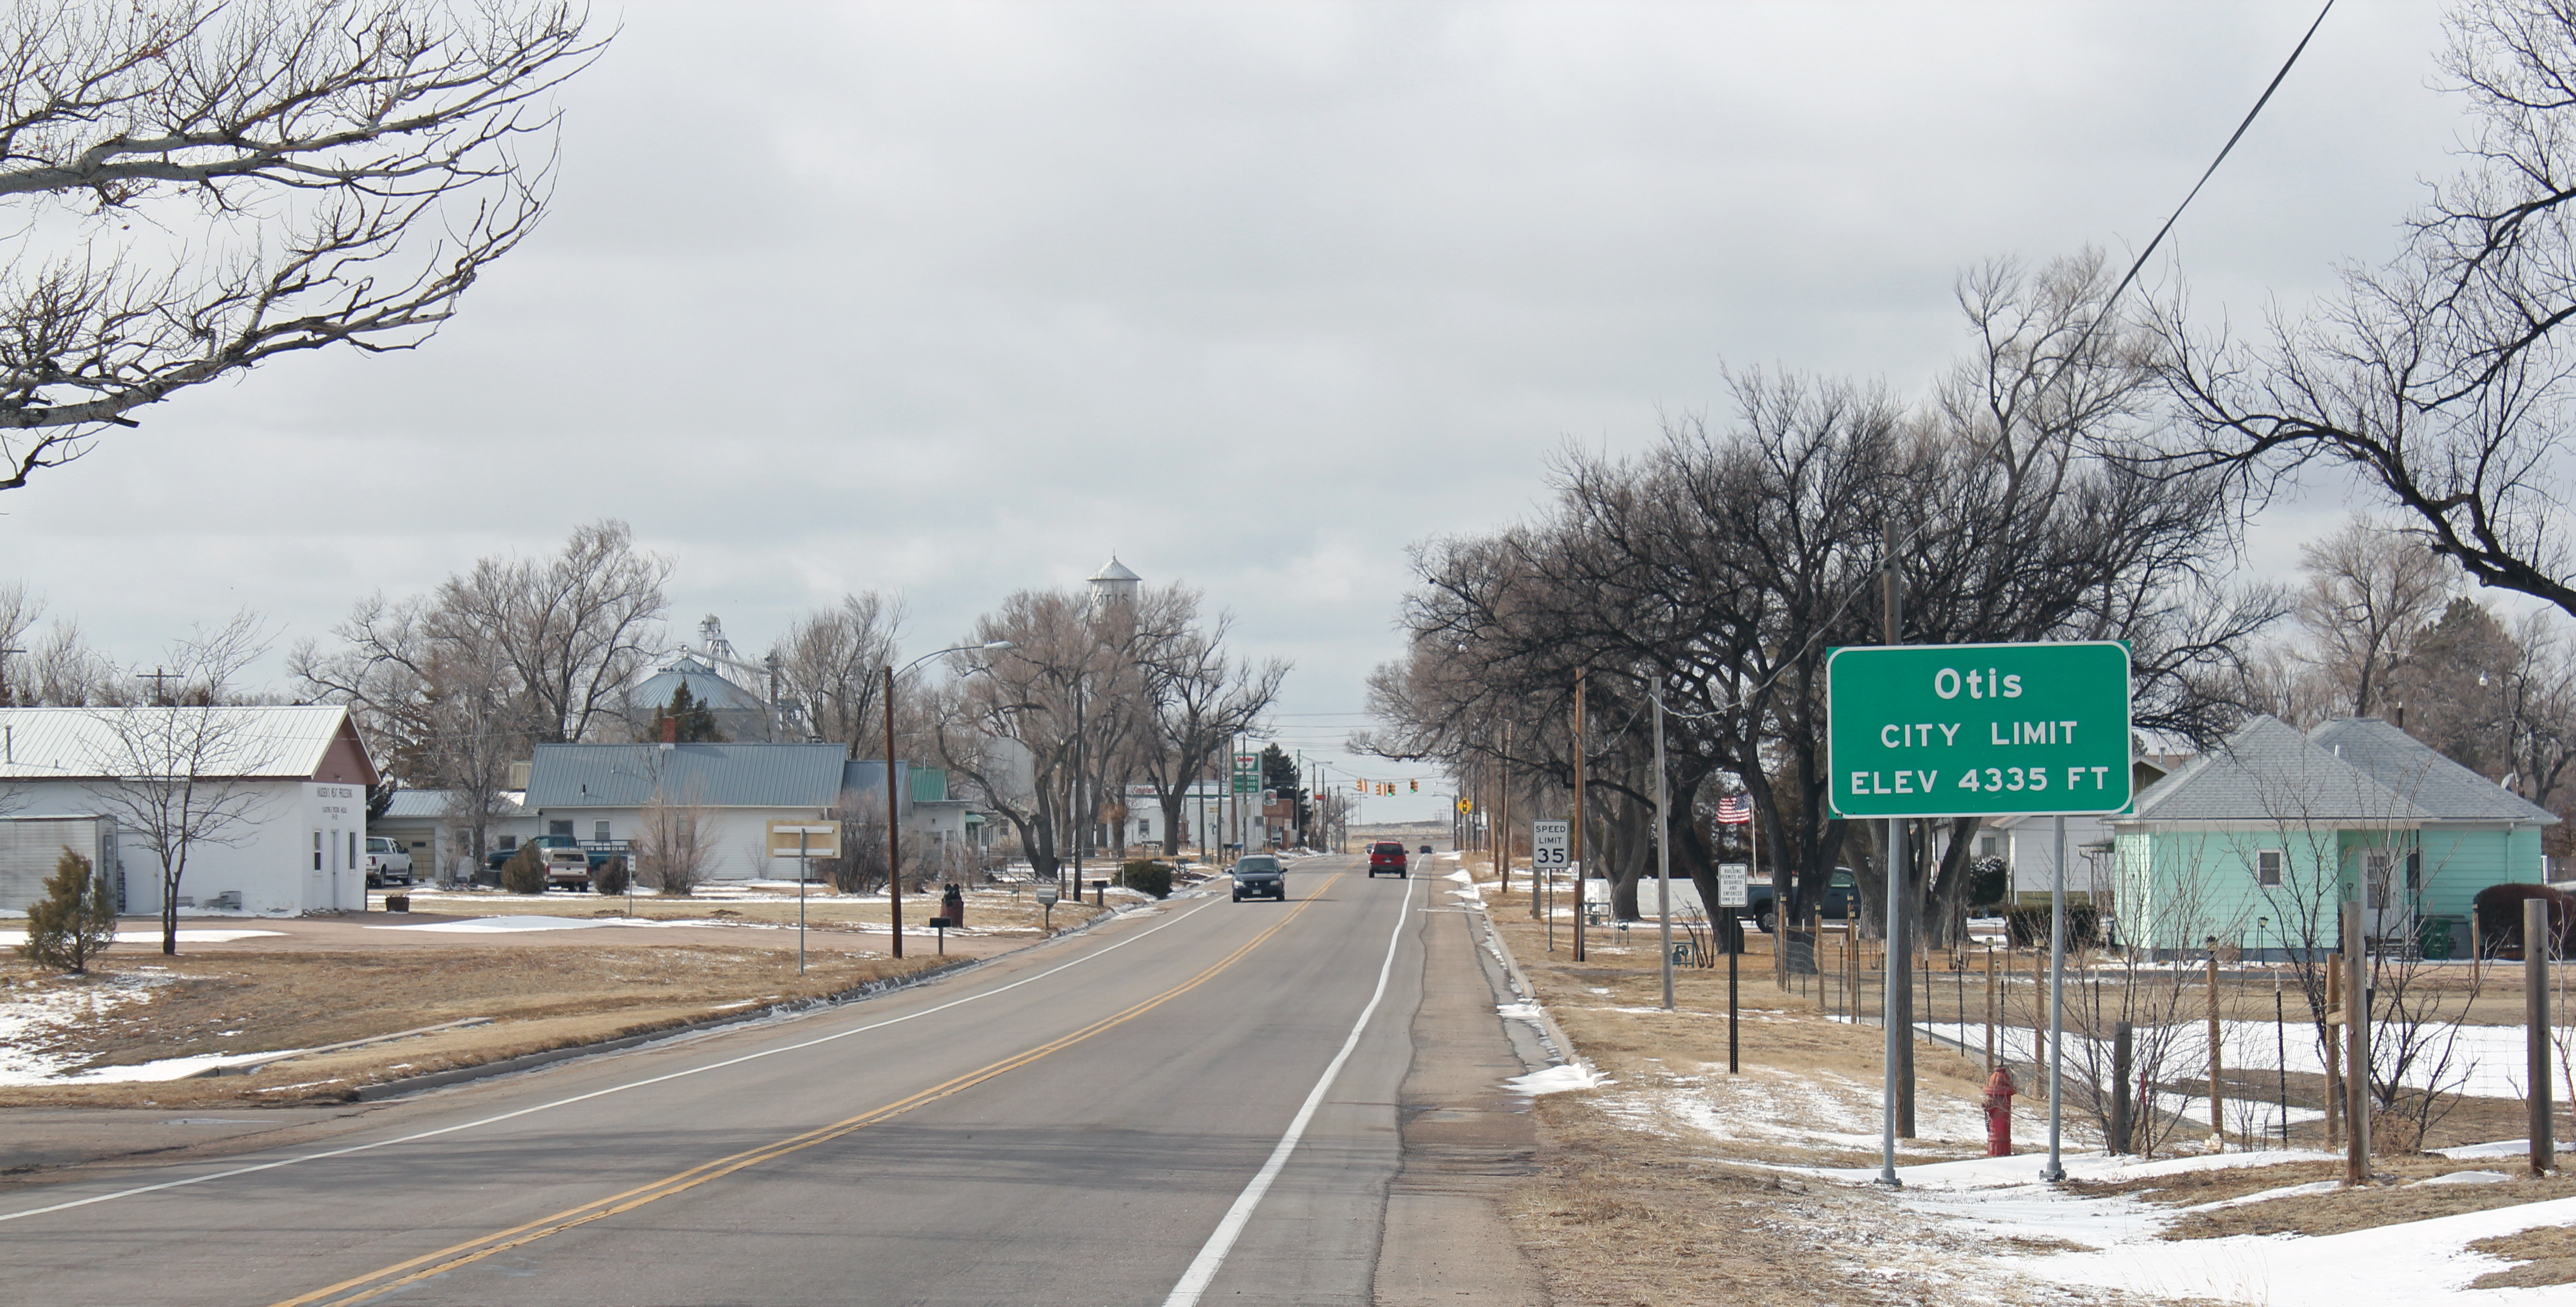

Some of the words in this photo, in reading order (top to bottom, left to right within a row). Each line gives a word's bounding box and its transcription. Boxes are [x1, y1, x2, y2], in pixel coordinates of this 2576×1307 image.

[1934, 668, 2022, 699] Otis
[1881, 723, 1961, 748] CITY
[1992, 721, 2077, 745] LIMIT
[1852, 770, 1937, 794] ELEV
[1958, 767, 2047, 792] 4335
[2068, 767, 2108, 790] FT
[1537, 848, 1564, 863] 35
